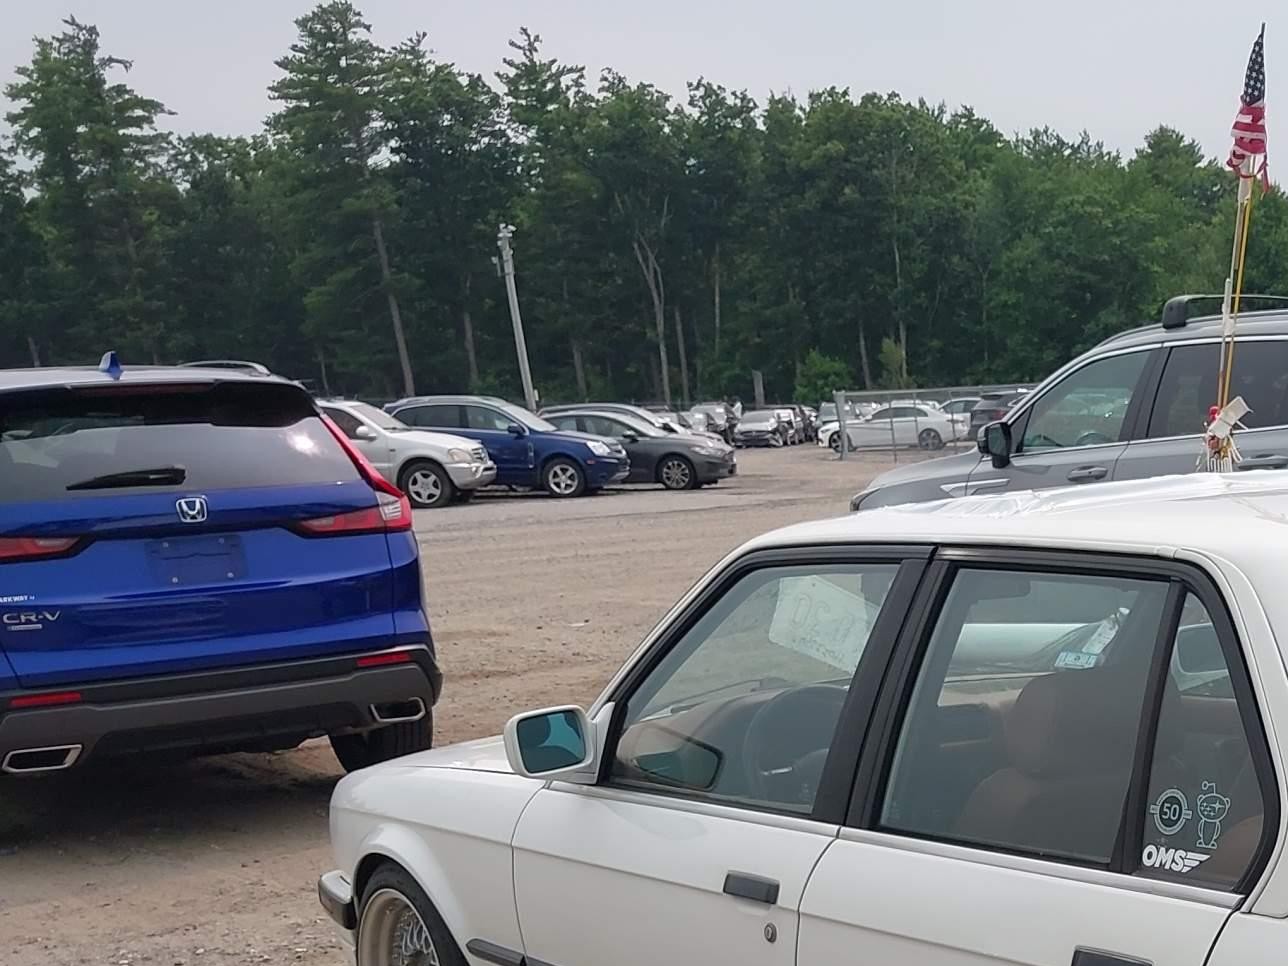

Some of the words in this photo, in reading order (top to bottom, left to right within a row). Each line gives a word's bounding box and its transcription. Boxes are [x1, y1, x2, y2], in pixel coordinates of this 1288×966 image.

[2, 610, 61, 624] CR-V
[1161, 802, 1180, 820] 50
[1142, 844, 1187, 873] OMS
